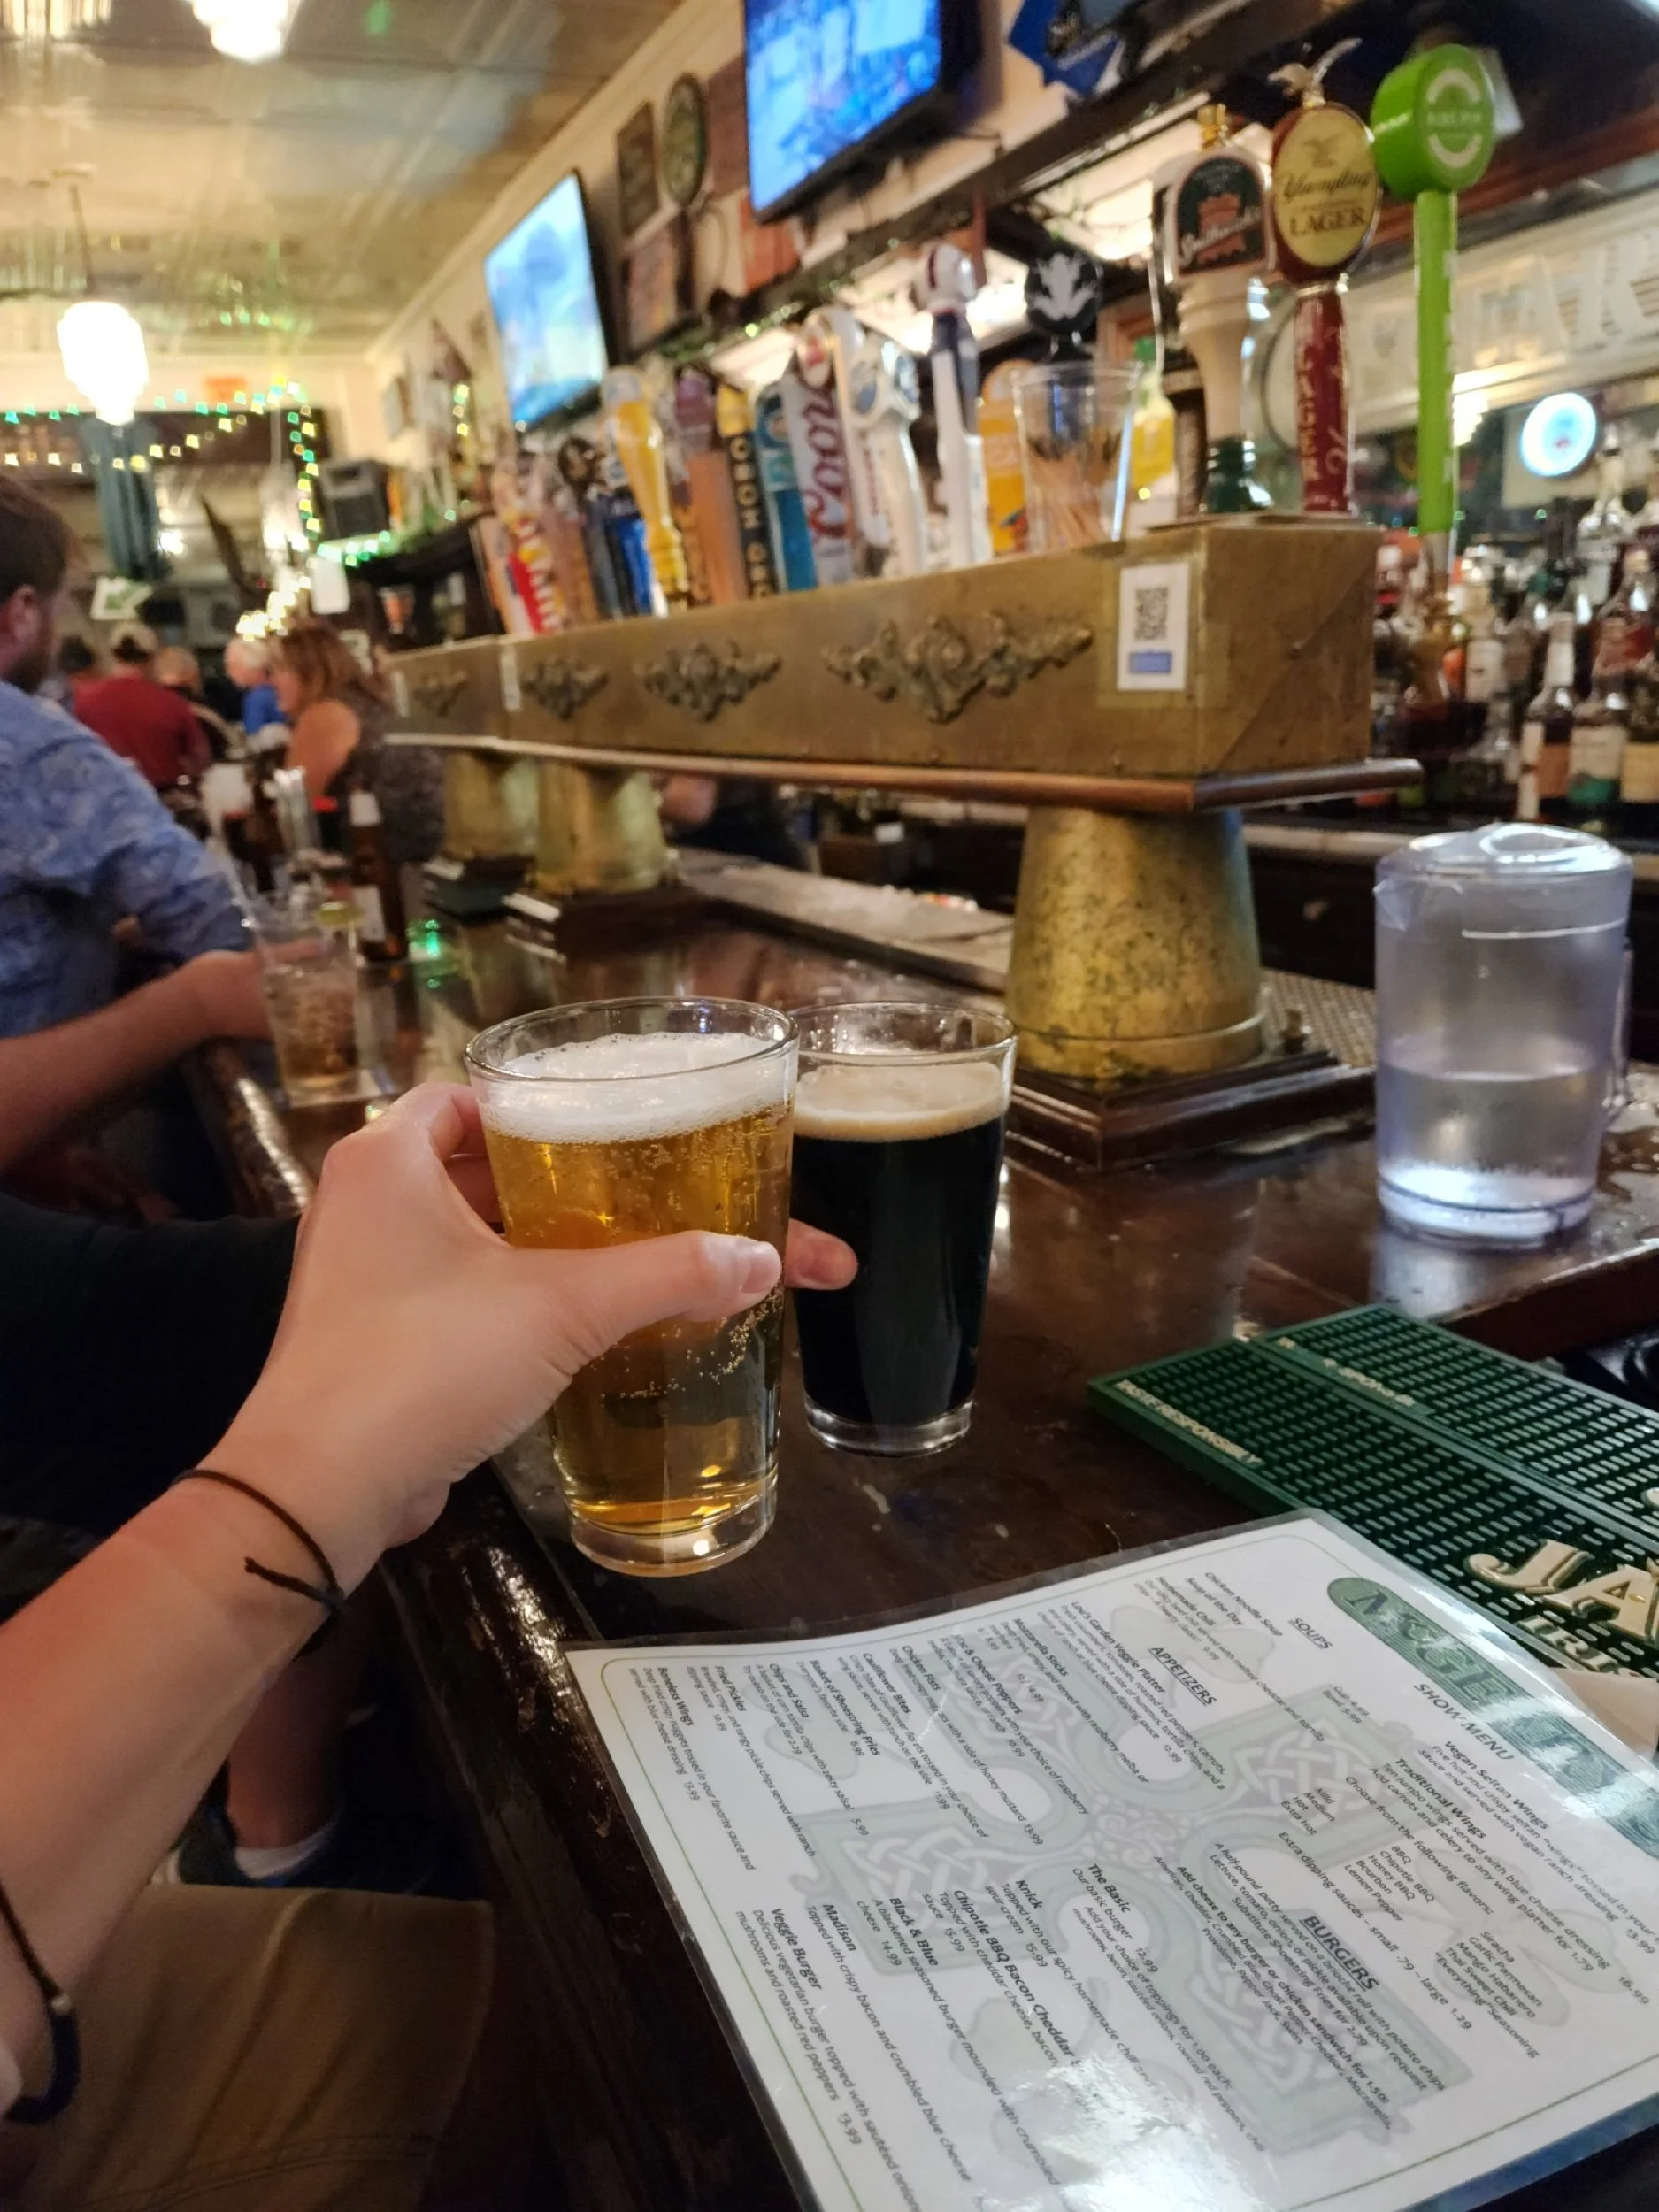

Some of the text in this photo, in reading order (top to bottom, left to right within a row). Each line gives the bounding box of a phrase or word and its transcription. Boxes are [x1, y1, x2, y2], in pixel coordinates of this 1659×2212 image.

[1289, 206, 1366, 236] LAGER
[1182, 1577, 1209, 1594] Soup
[1203, 1571, 1284, 1638] Chicken Noodle Soup
[1463, 1537, 1659, 1646] JA
[1011, 1617, 1071, 1677] Mozzarella Sticks
[1087, 1618, 1118, 1644] Garden
[1110, 1642, 1142, 1670] Veggie
[1135, 1667, 1166, 1694] Platter
[1289, 1617, 1333, 1649] SOUPS
[711, 1665, 749, 1711] Fried Pickles
[764, 1663, 789, 1683] Chips
[789, 1698, 812, 1718] Salsa
[861, 1652, 914, 1714] Cauliflower Bites
[901, 1644, 943, 1691] Chicken Fists
[969, 1655, 1025, 1715] Cheese Poppers
[1149, 1646, 1216, 1705] APPETIZERS
[656, 1665, 696, 1728] Boneless Wings
[809, 1659, 835, 1684] Basket
[828, 1694, 870, 1735] Shoestring
[859, 1735, 884, 1755] Fries
[1412, 1683, 1515, 1761] SHOW MENU
[1290, 1795, 1310, 1811] Hot
[1302, 1791, 1338, 1822] Medium
[1314, 1786, 1335, 1804] Mild
[1393, 1757, 1489, 1840] Traditional Wings
[1440, 1740, 1480, 1771] Vegan
[1508, 1797, 1551, 1832] Wings
[1279, 1799, 1319, 1836] Extra Hot
[1343, 1775, 1380, 1806] Choose
[1373, 1803, 1402, 1826] from
[1395, 1824, 1417, 1840] the
[1409, 1839, 1461, 1883] following
[1175, 1864, 1199, 1883] Add
[1354, 1858, 1394, 1895] Bourbon
[1363, 1854, 1417, 1901] Honey BBQ
[1367, 1766, 1393, 1785] Add
[1385, 1782, 1422, 1811] carrots
[1415, 1810, 1440, 1828] and
[1431, 1826, 1467, 1854] celery
[1460, 1852, 1479, 1864] to
[1470, 1863, 1495, 1882] any
[1488, 1879, 1522, 1905] wing
[1513, 1902, 1555, 1936] platter
[1550, 1934, 1573, 1951] for
[1375, 1849, 1437, 1904] Chipotle BBQ
[1389, 1845, 1411, 1864] BBQ
[919, 1892, 945, 1922] sauce
[982, 1884, 1005, 1907] sour
[995, 1904, 1025, 1935] cream
[1013, 1878, 1046, 1909] Knick
[1070, 1866, 1093, 1886] Our
[1083, 1883, 1110, 1909] basic
[1098, 1907, 1134, 1940] burger
[1086, 1863, 1133, 1912] The Basic
[1189, 1881, 1223, 1911] cheese
[1341, 1863, 1405, 1923] Lemon Pepper
[733, 1910, 774, 1967] mushrooms
[820, 1903, 862, 1951] Madison
[887, 1896, 944, 1966] Black & Blue
[1215, 1909, 1233, 1922] to
[1221, 1921, 1245, 1939] any
[1276, 1831, 1307, 1855] Extra
[1294, 1853, 1339, 1890] dipping
[1330, 1887, 1365, 1919] sauces
[1367, 1924, 1401, 1953] small
[1415, 1977, 1452, 2007] large
[764, 1908, 826, 1988] Veggie Burger
[1229, 1896, 1275, 1939] Substitute
[1264, 1939, 1317, 1988] Shoestring
[1309, 1985, 1338, 2010] Fries
[1328, 2008, 1350, 2025] for
[1235, 1936, 1273, 1970] burger
[1291, 1946, 1306, 1958] or
[1298, 1955, 1333, 1986] pickle
[1301, 1915, 1379, 1991] BURGERS
[1479, 1930, 1517, 1963] Siracha
[762, 1967, 785, 1988] and
[948, 1888, 1079, 2057] Chipotle BBQ Bacon Cheddar
[1265, 1968, 1281, 1980] or
[1443, 1946, 1519, 2017] Thai Sweet Chili
[1452, 1940, 1539, 2019] Mango Habanero
[1466, 1935, 1545, 2008] Garlic Parmesan
[772, 1988, 807, 2031] roasted
[1275, 1979, 1316, 2016] chicken
[1325, 1982, 1370, 2026] available
[795, 2031, 818, 2051] red
[800, 1905, 976, 2182] Topped with crispy bacon and crumbled blue cheese
[1307, 2016, 1356, 2063] sandwich
[1359, 2024, 1391, 2053] upon
[801, 2052, 840, 2101] peppers
[1347, 2061, 1371, 2079] for
[1383, 2049, 1429, 2093] request
